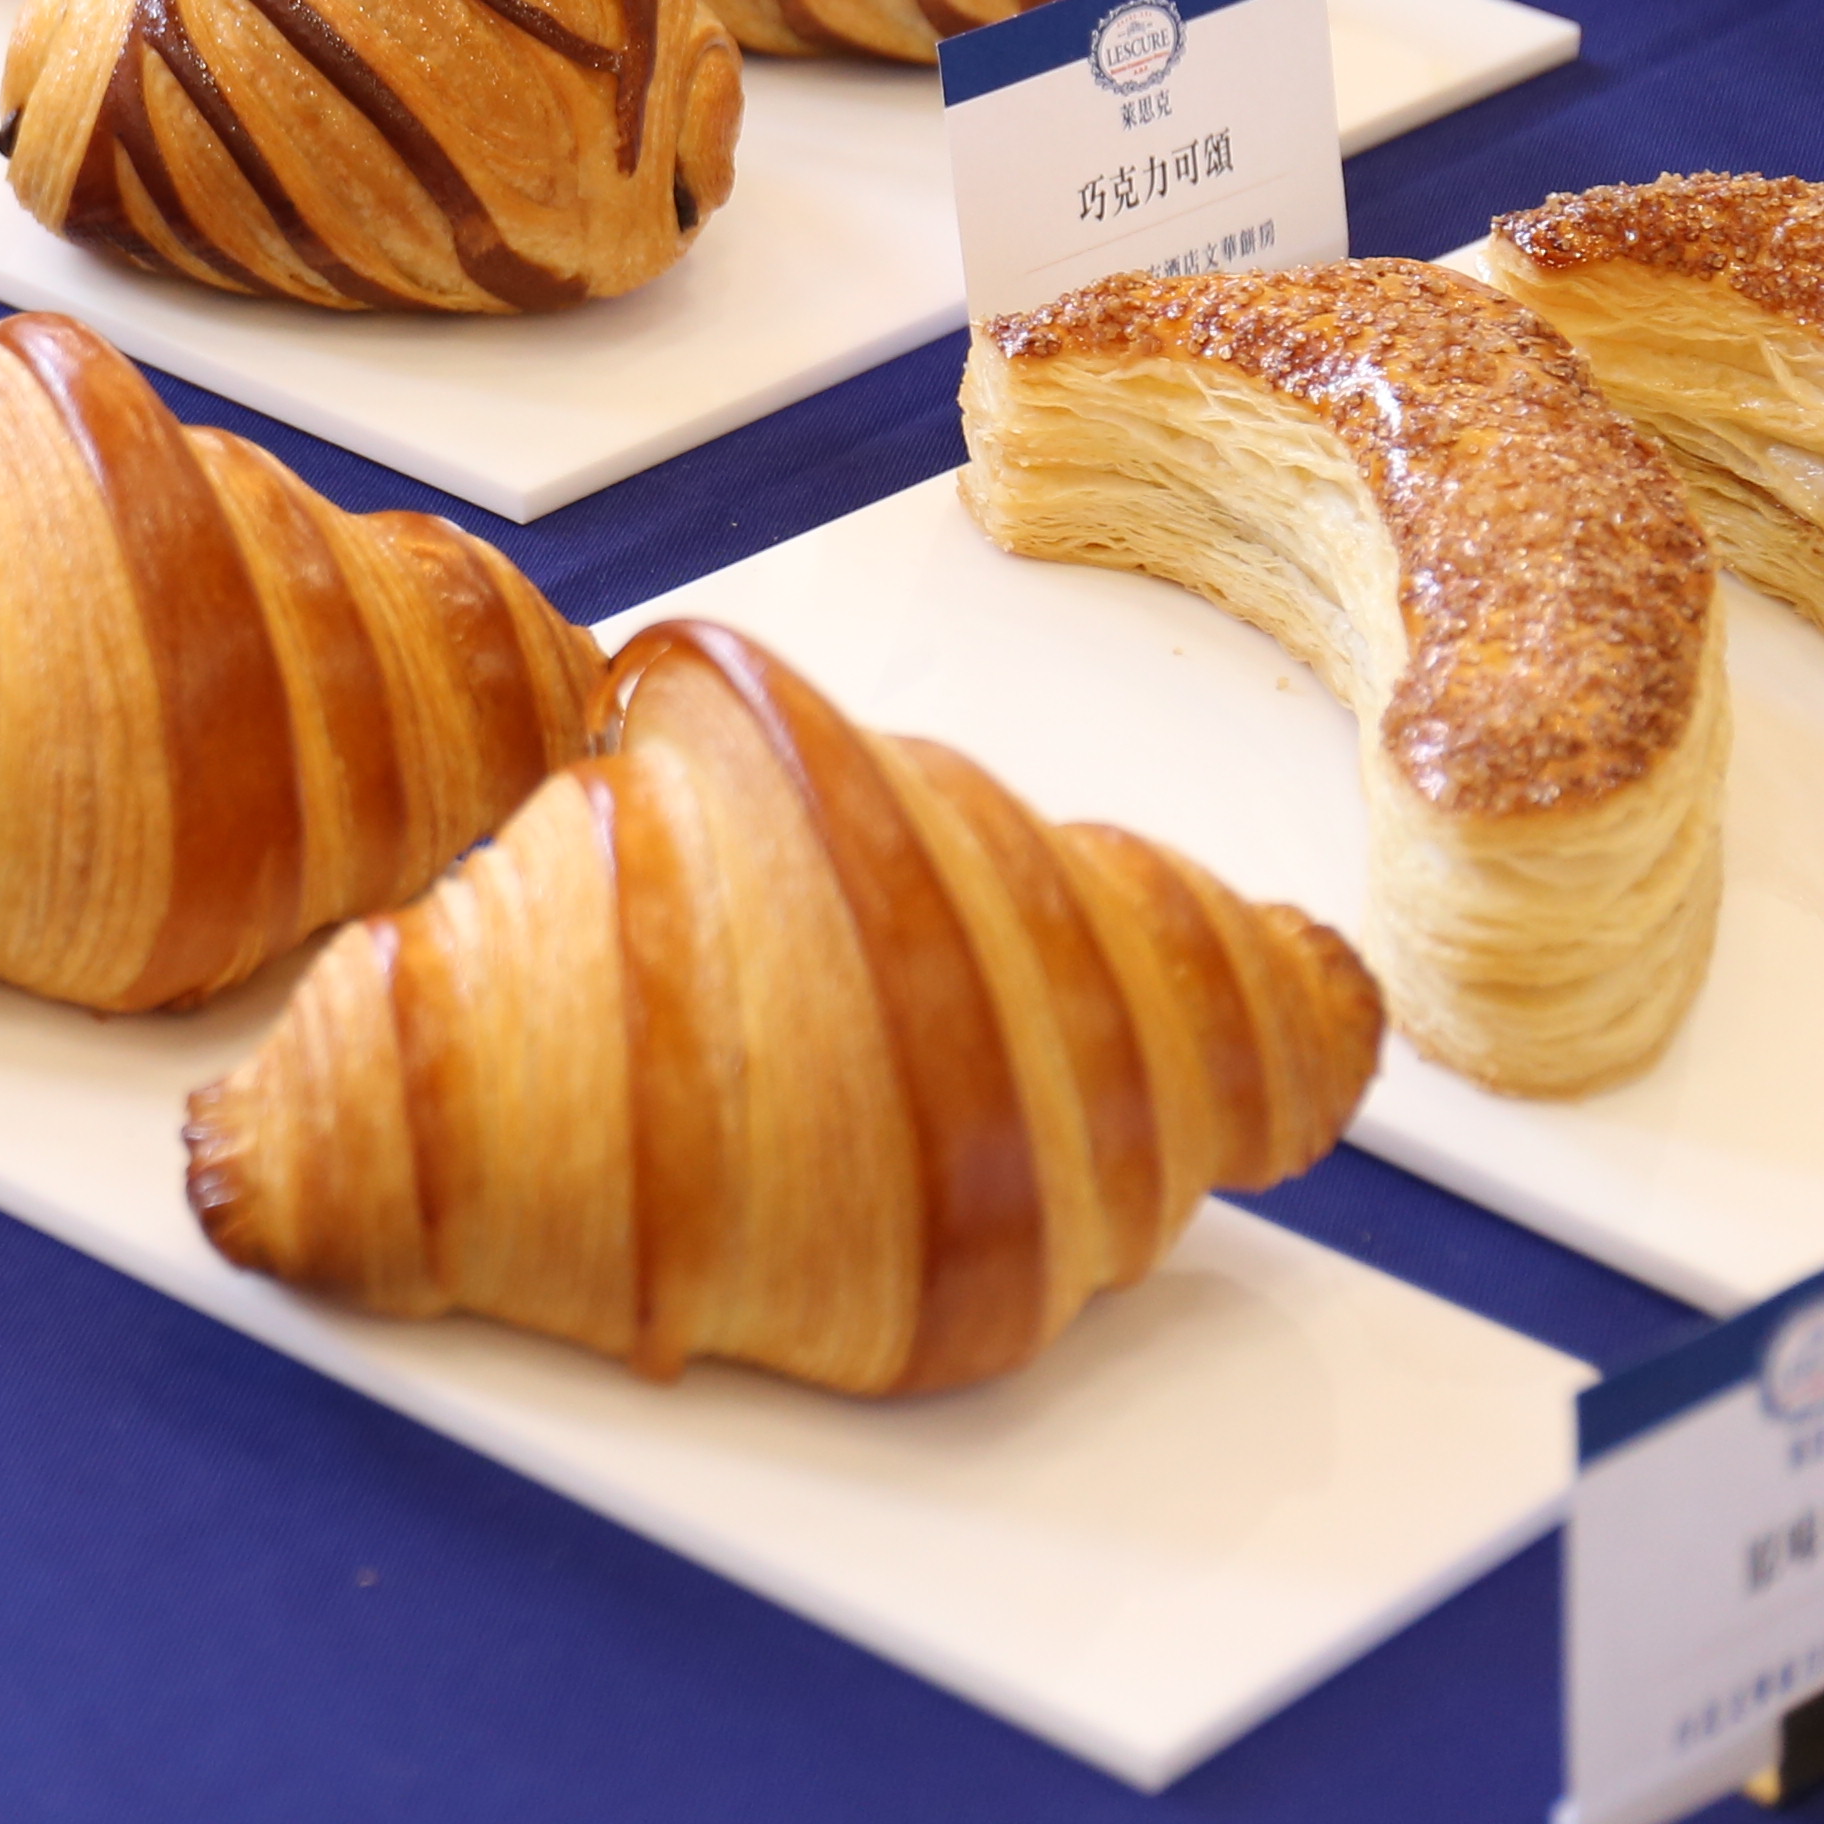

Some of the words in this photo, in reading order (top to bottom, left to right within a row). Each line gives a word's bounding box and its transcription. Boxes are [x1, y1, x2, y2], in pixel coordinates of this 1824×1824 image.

[1105, 28, 1171, 67] LESCURE
[1120, 89, 1173, 131] 萊思克
[1078, 127, 1233, 222] 巧克力可頌
